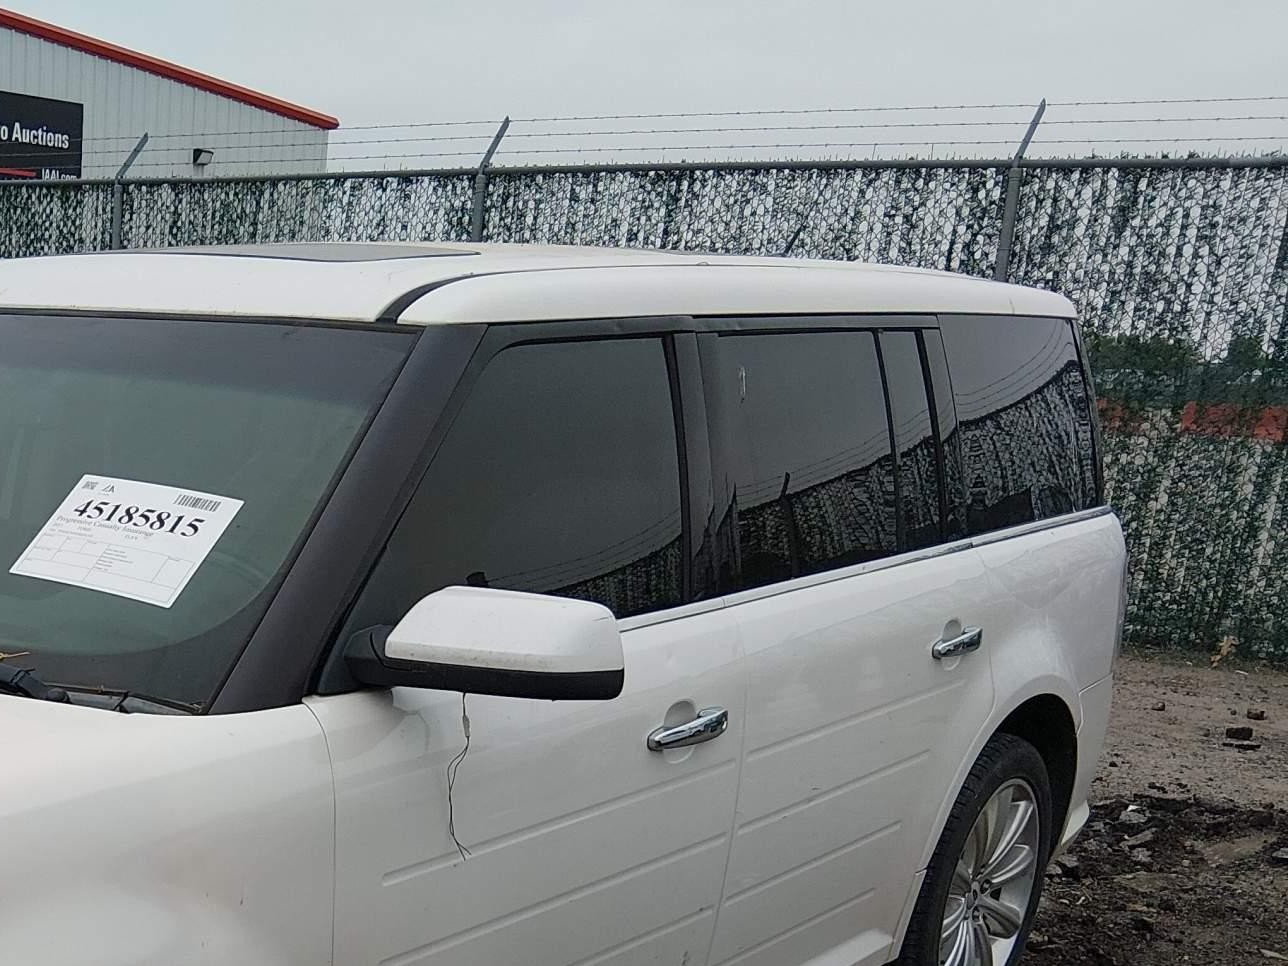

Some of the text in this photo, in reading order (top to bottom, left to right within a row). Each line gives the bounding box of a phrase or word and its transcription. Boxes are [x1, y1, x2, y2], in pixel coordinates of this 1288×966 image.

[12, 122, 69, 149] Auctions
[41, 168, 77, 182] IAAIco
[74, 499, 205, 537] 45185815
